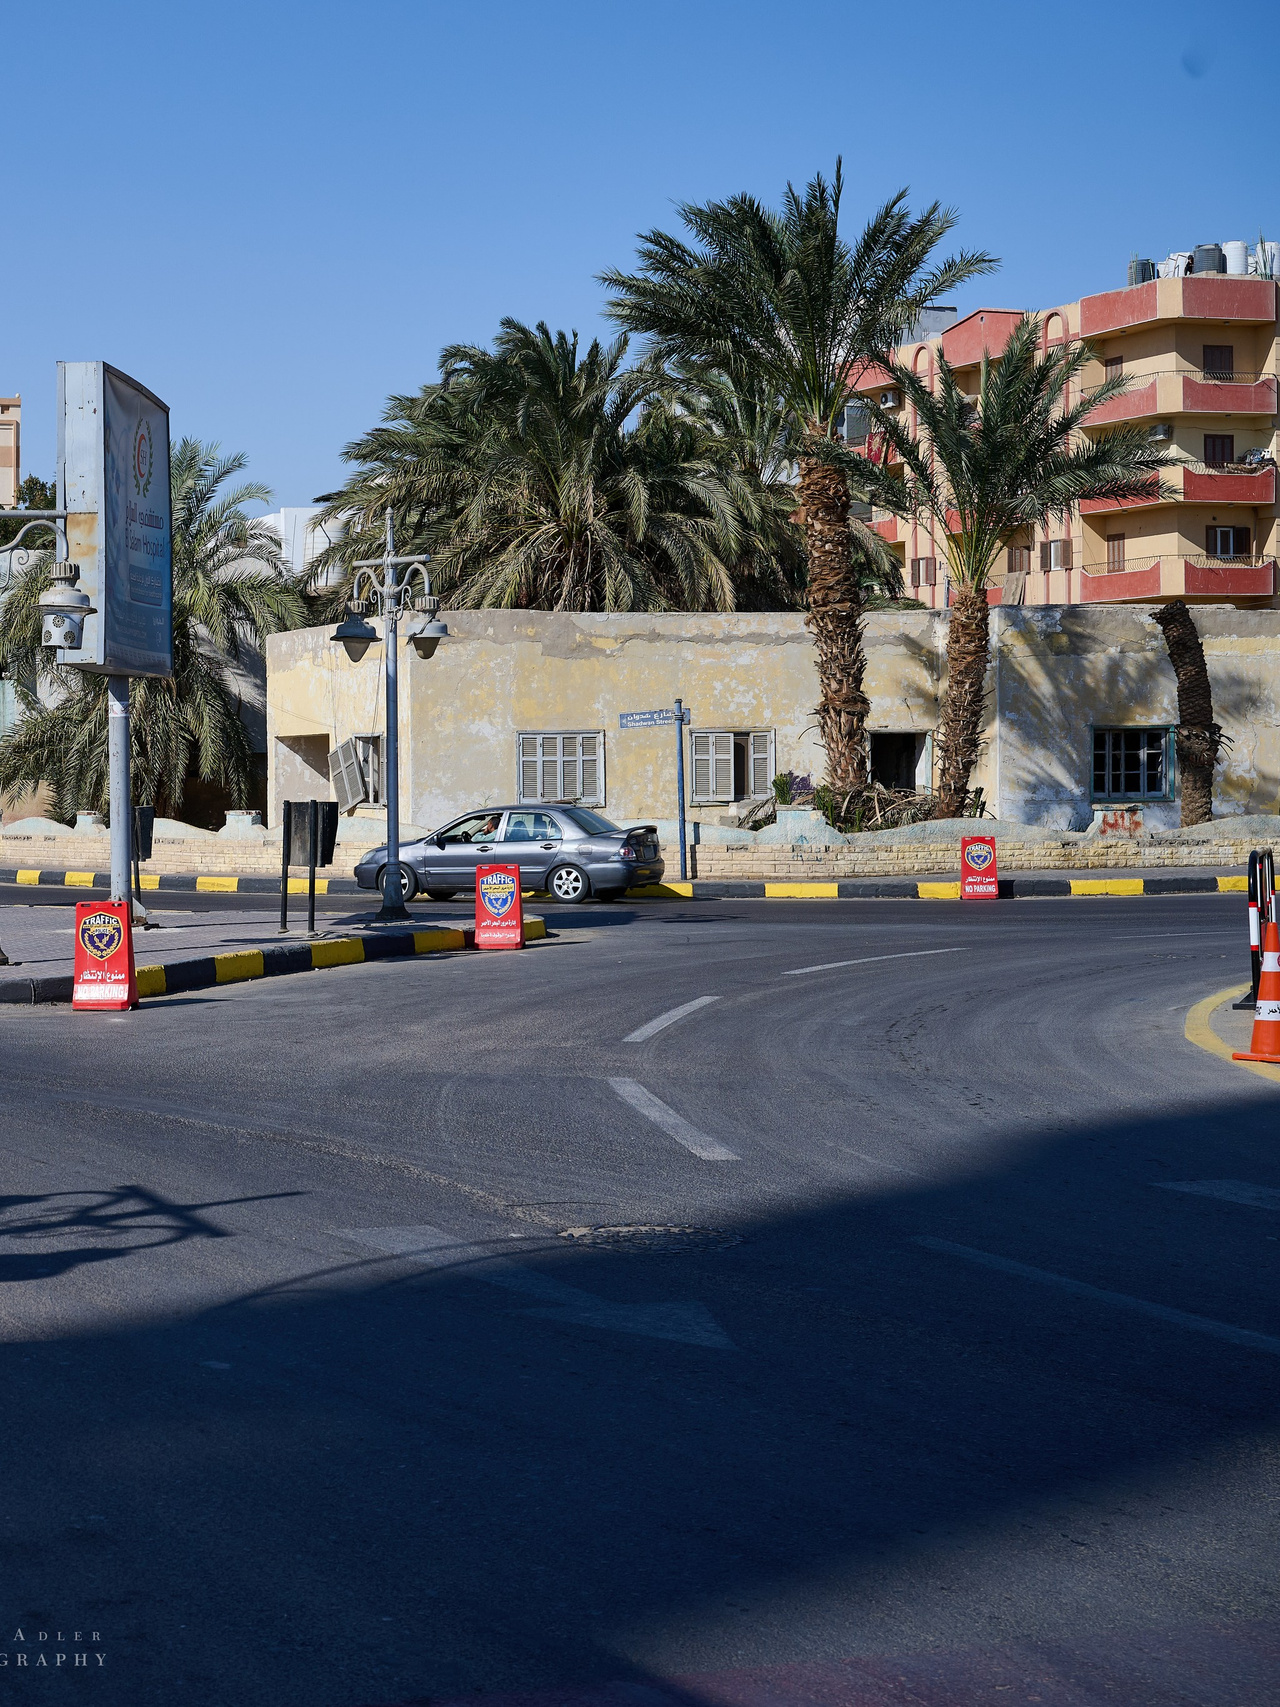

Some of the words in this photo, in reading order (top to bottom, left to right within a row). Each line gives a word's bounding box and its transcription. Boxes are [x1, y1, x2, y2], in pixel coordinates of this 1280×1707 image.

[627, 719, 655, 728] Shadwan
[484, 873, 513, 885] TRAFFIC
[983, 876, 995, 884] ممنوع
[965, 885, 974, 893] NO
[974, 885, 996, 893] PARKING
[85, 915, 118, 925] TRAFFIC
[106, 970, 125, 982] ممنوع
[76, 985, 90, 999] NO
[91, 985, 124, 999] PARKING
